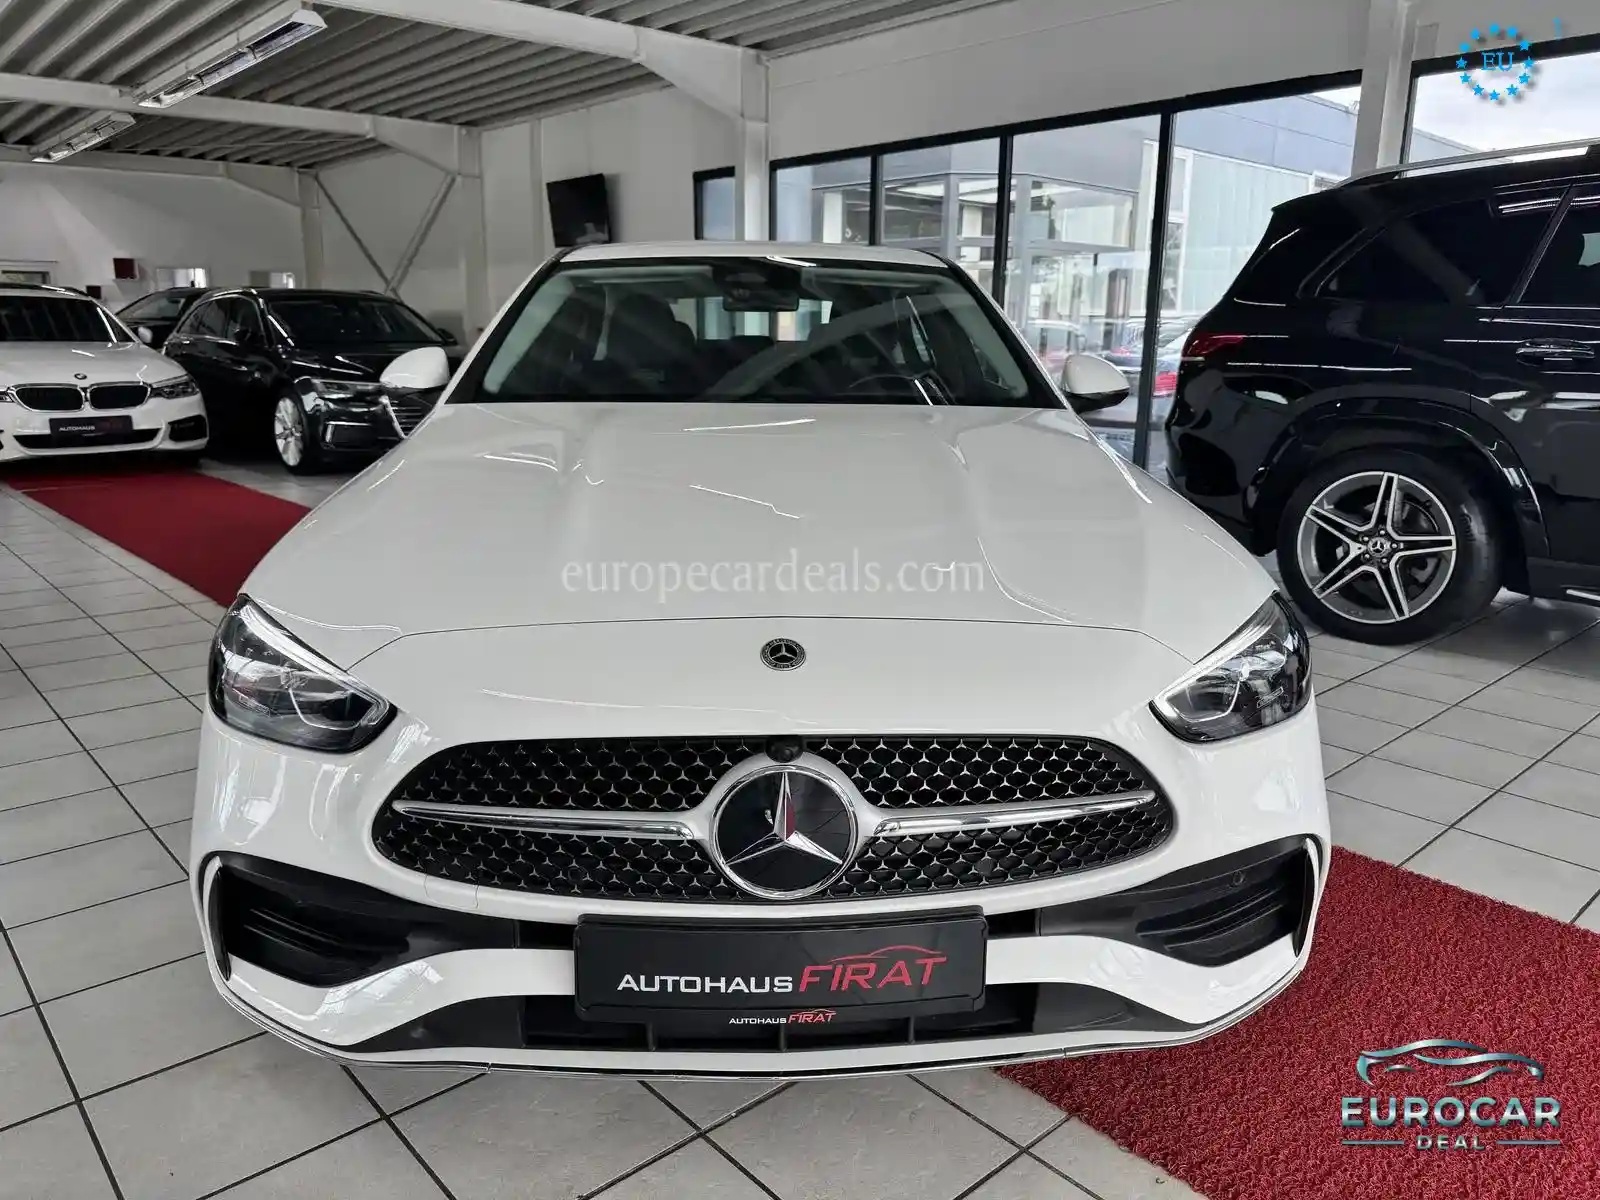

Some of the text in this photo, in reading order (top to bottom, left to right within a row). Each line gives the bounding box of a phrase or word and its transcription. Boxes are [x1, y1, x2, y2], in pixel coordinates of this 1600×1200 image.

[617, 956, 947, 993] AUTOHAUS FIRAT
[729, 1012, 836, 1025] AUTOHAUS FIRAT
